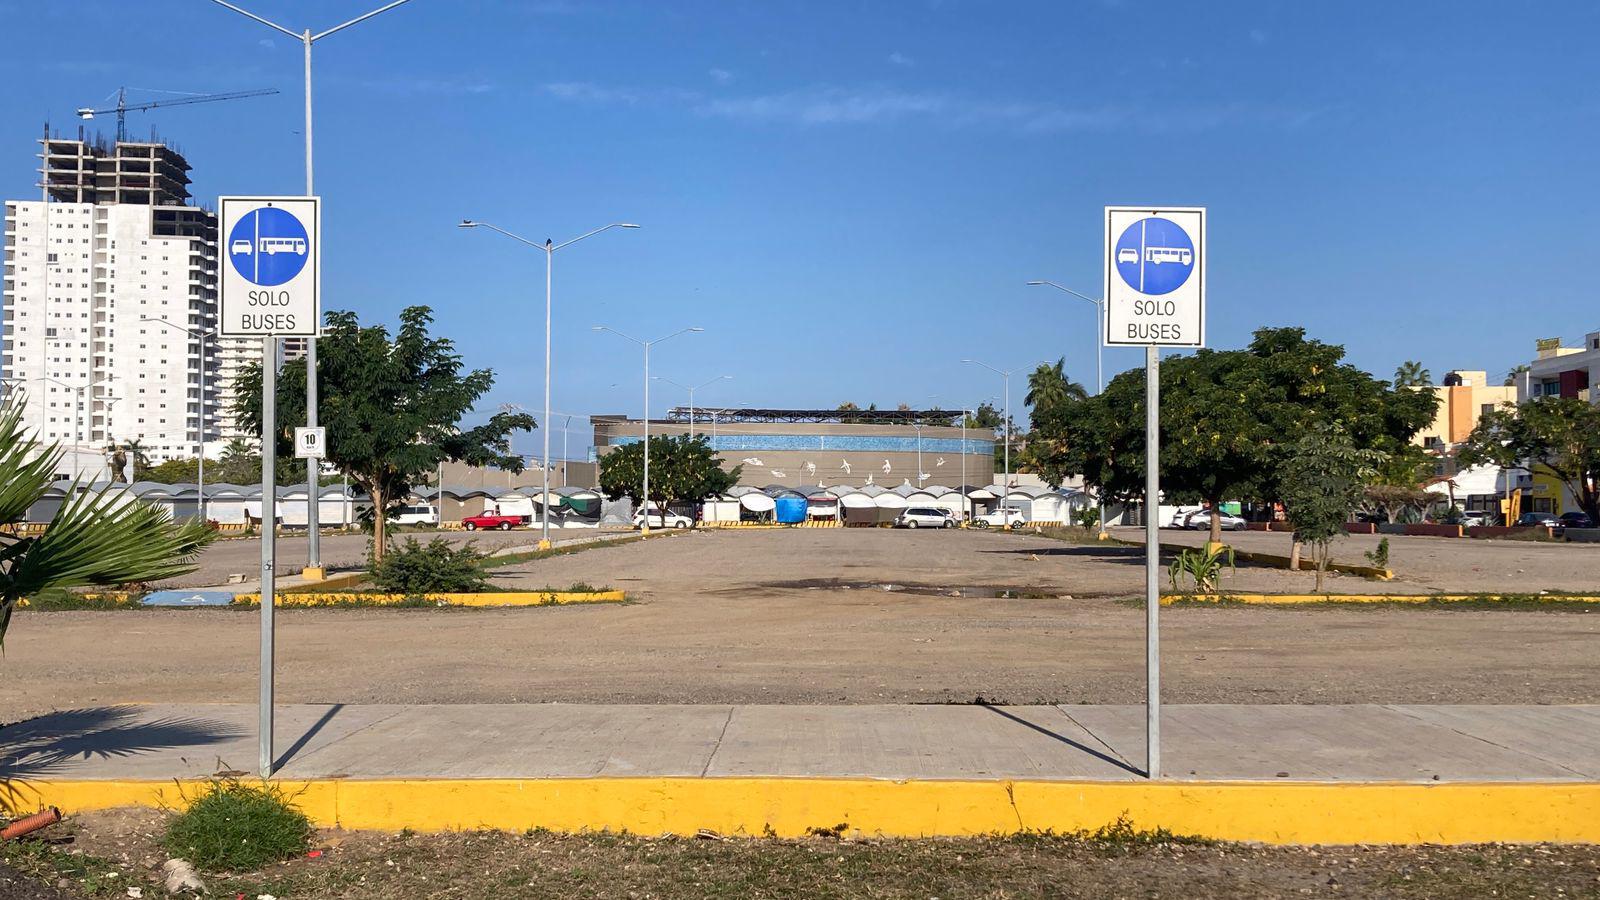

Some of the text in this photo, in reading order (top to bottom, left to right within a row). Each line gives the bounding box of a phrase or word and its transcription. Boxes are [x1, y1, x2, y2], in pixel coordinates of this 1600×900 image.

[248, 290, 290, 306] SOLO
[1134, 300, 1176, 316] SOLO
[241, 314, 296, 330] BUSES
[1128, 323, 1181, 340] BUSES
[304, 433, 316, 445] 10
